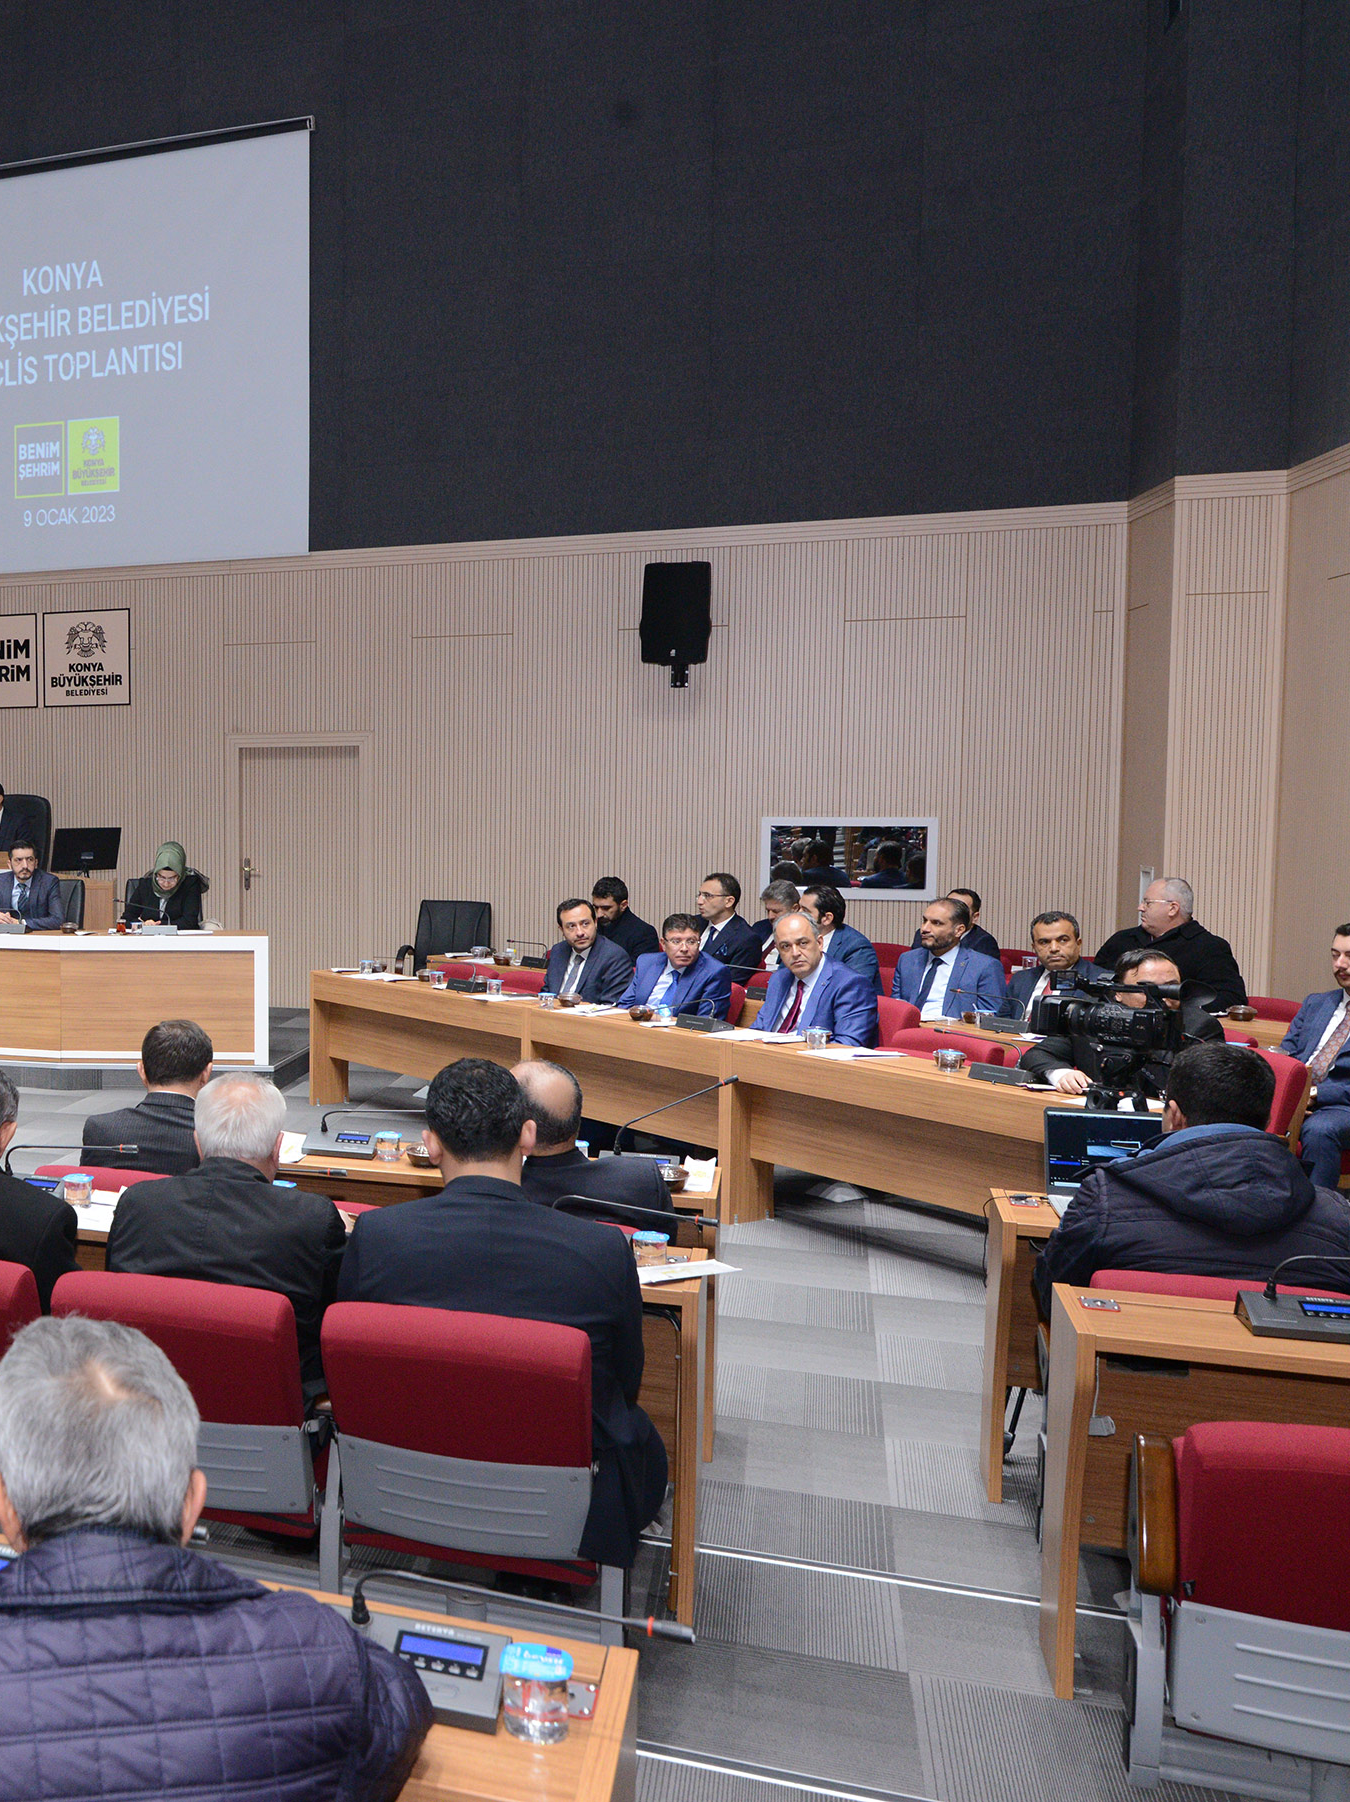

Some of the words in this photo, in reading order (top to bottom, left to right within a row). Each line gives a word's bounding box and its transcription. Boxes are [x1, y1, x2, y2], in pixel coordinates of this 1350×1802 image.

[23, 260, 103, 296] KONYA
[78, 285, 209, 335] BELEDİYESİ
[44, 341, 182, 382] TOPLANTISI
[23, 510, 32, 527] 9
[36, 506, 79, 526] OCAK
[81, 504, 116, 524] 2023
[68, 662, 104, 672] KONYA
[50, 671, 123, 689] BÜYÜKŞEHİR
[65, 687, 108, 697] BELEDİYESİ
